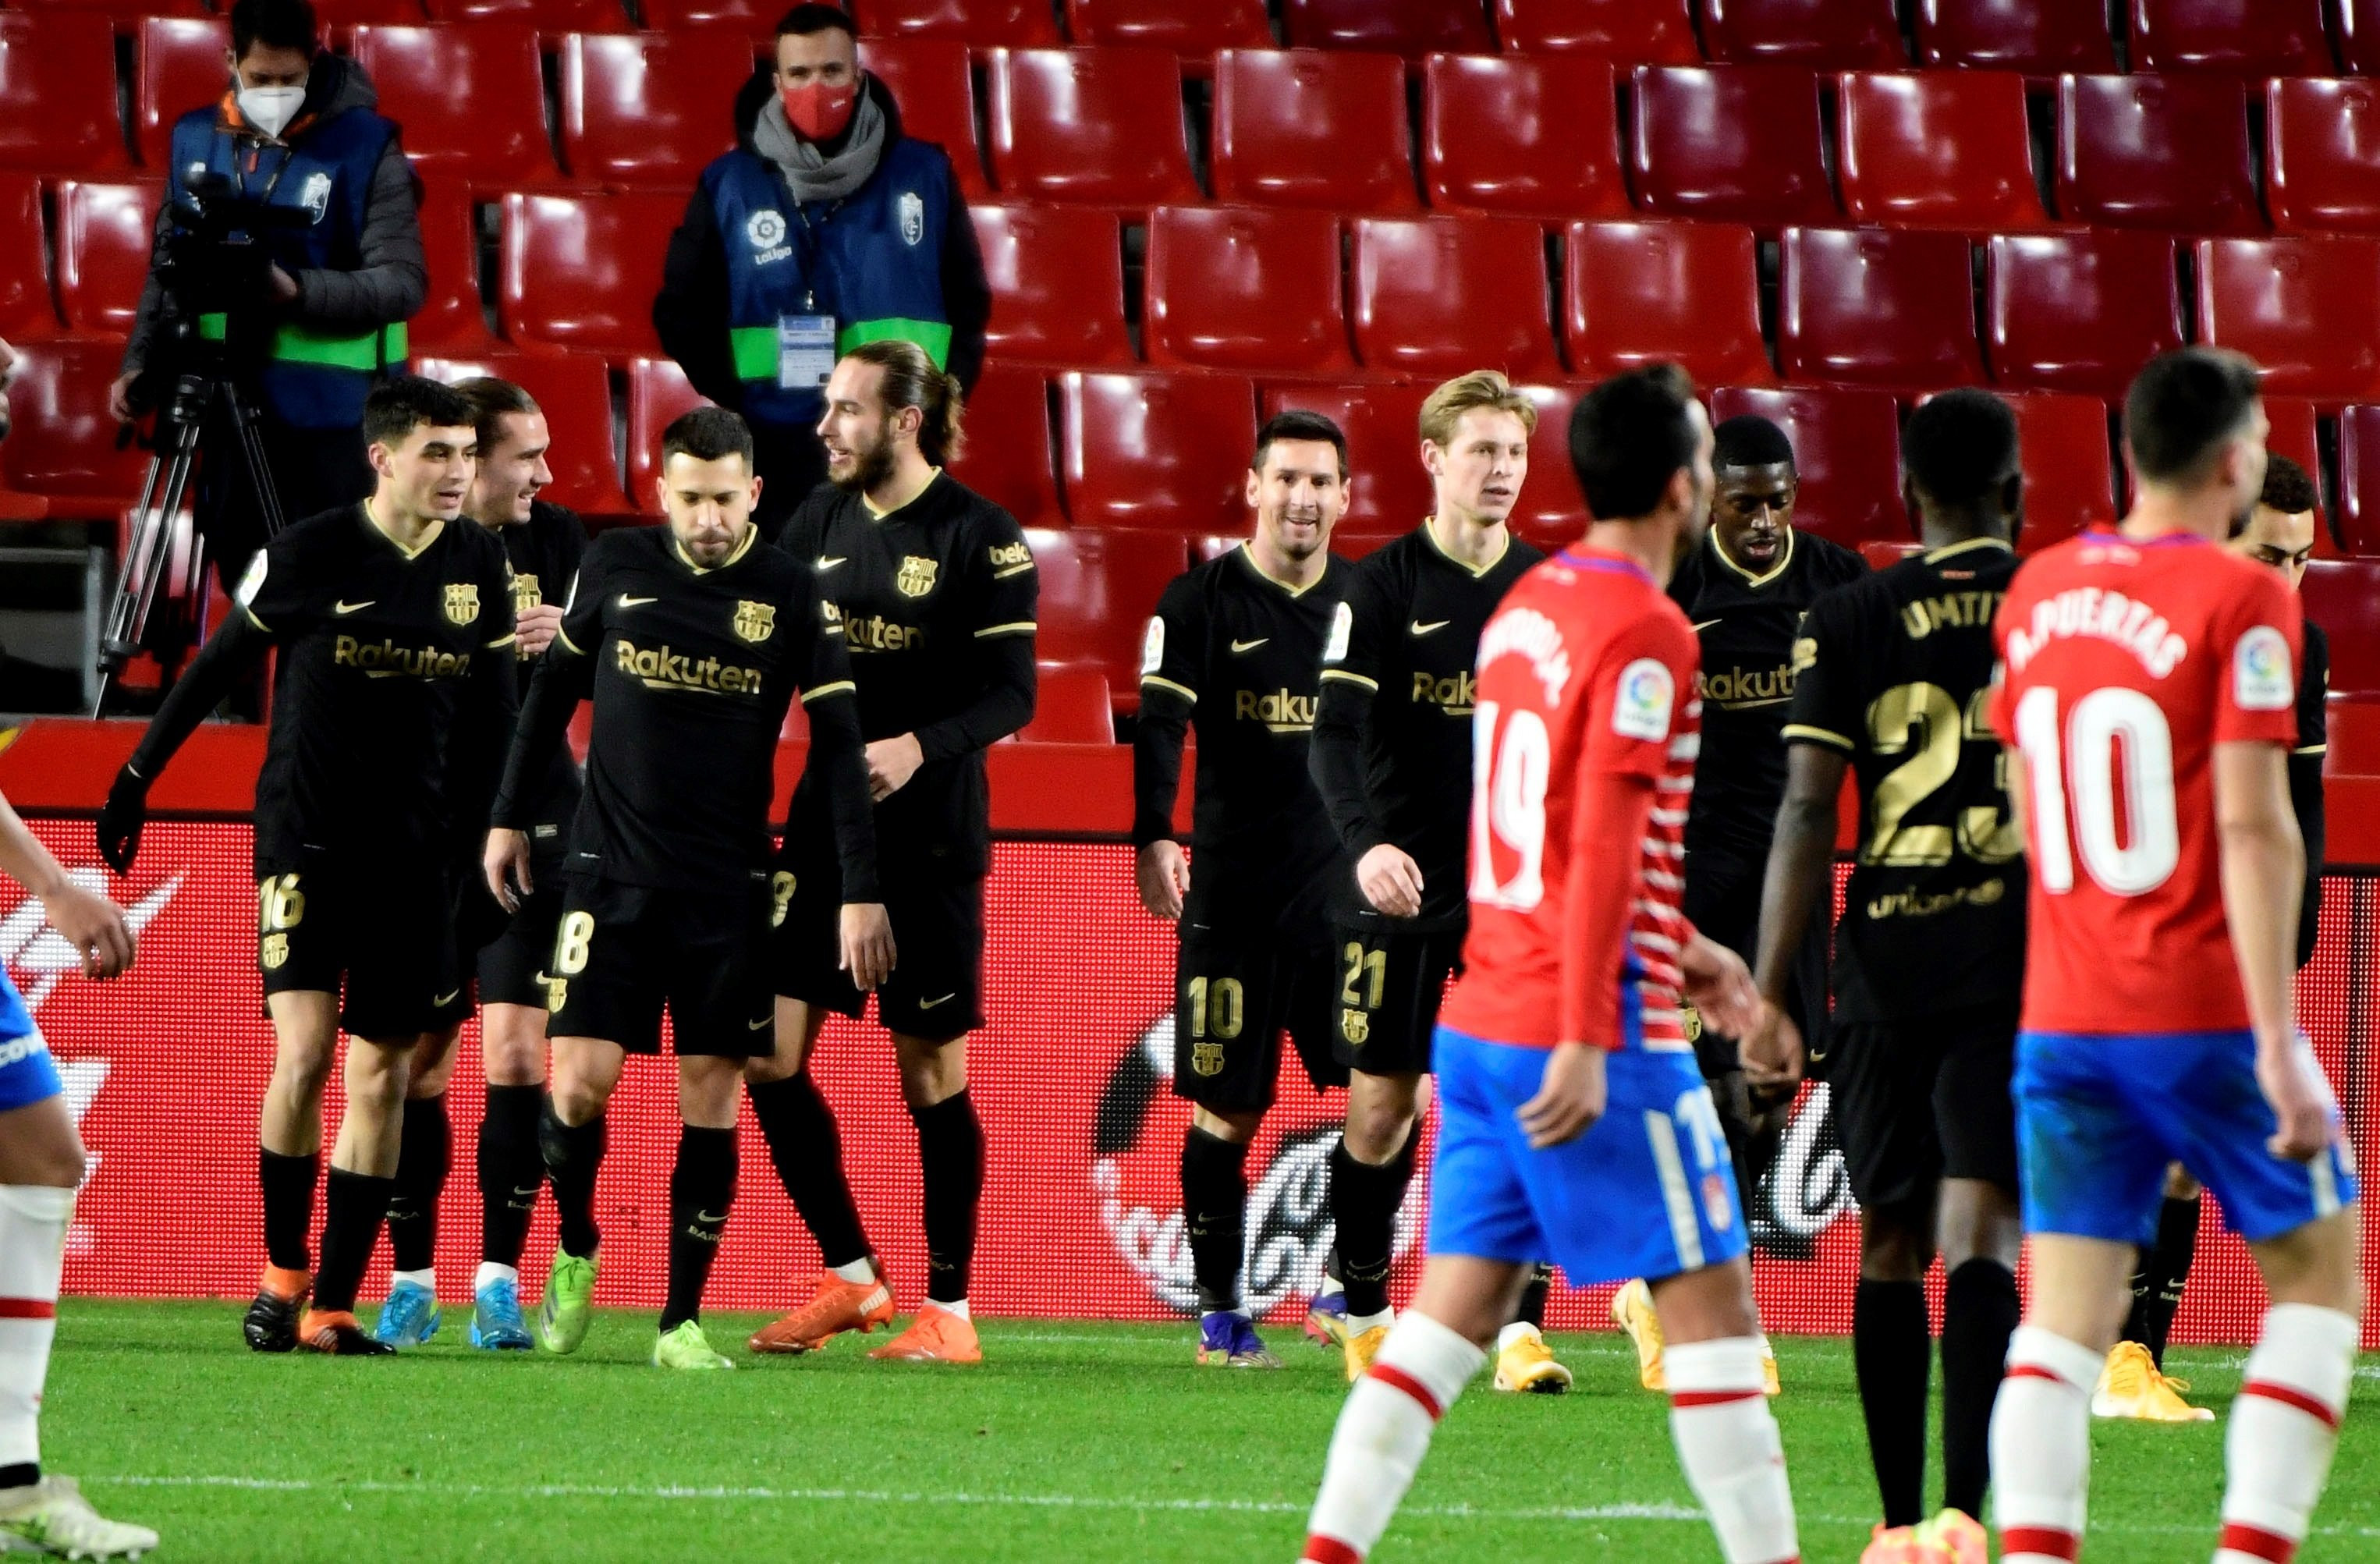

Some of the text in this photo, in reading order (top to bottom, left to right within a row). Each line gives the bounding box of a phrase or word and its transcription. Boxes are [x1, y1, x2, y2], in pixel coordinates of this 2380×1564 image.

[754, 246, 793, 265] LaLiga
[988, 541, 1031, 566] bek
[844, 609, 924, 650] kuten
[1901, 590, 2006, 640] UMTI
[617, 640, 762, 695] Rakuten
[1236, 688, 1318, 722] Raku
[1467, 700, 1551, 914] 19
[2013, 686, 2180, 896] 10
[260, 873, 305, 933] 16
[1342, 942, 1386, 1009] 21
[1188, 976, 1243, 1038] 10
